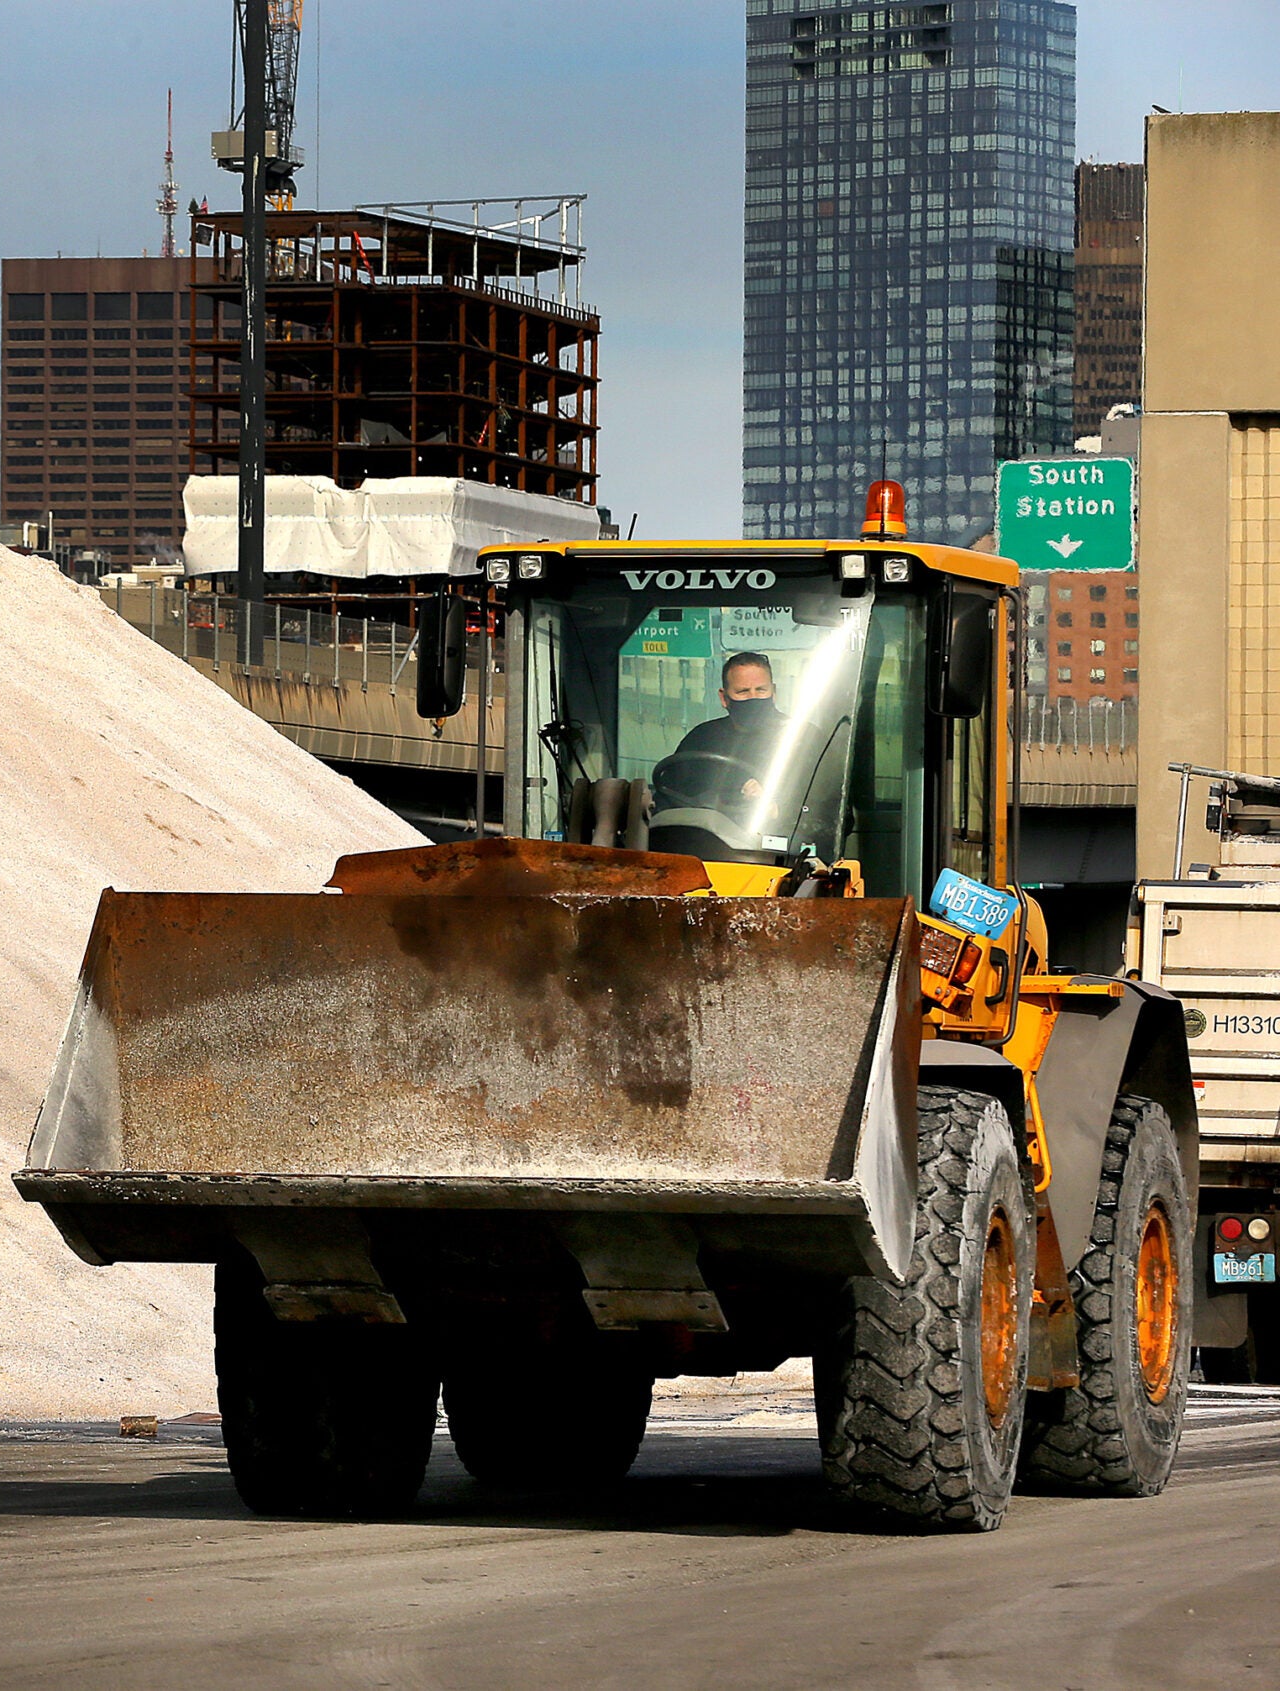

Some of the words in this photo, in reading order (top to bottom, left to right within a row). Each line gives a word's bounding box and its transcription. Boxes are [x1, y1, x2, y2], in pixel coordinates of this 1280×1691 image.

[1028, 464, 1104, 485] South
[1016, 495, 1115, 517] Station
[619, 569, 776, 590] VOLVO
[634, 626, 679, 638] irport
[729, 625, 783, 637] Station
[644, 642, 667, 653] TOLL
[938, 882, 1009, 928] MB1389
[1222, 1261, 1265, 1276] MB961
